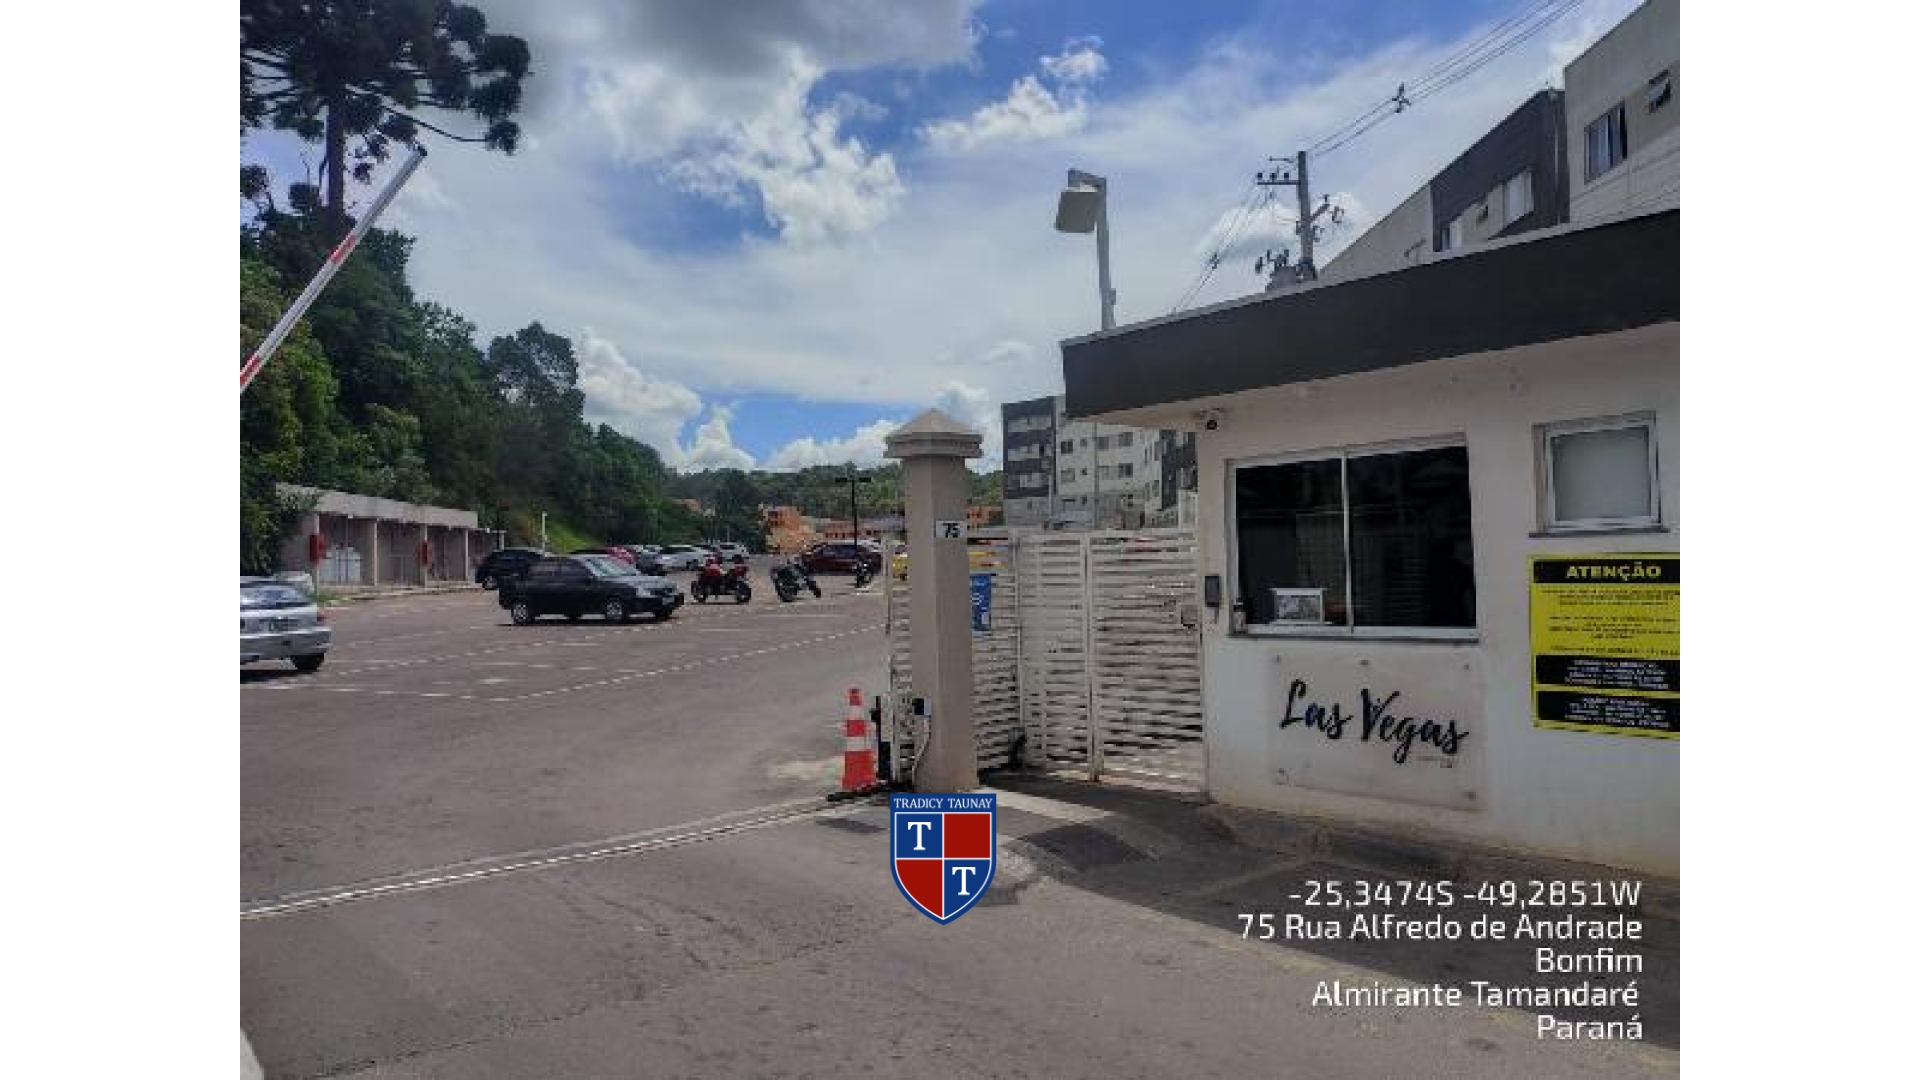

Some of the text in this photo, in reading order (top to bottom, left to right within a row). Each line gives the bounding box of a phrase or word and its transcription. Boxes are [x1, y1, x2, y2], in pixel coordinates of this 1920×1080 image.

[943, 523, 959, 538] 75
[1566, 561, 1662, 581] ATENÇÃO
[1279, 679, 1469, 764] Las Vegas
